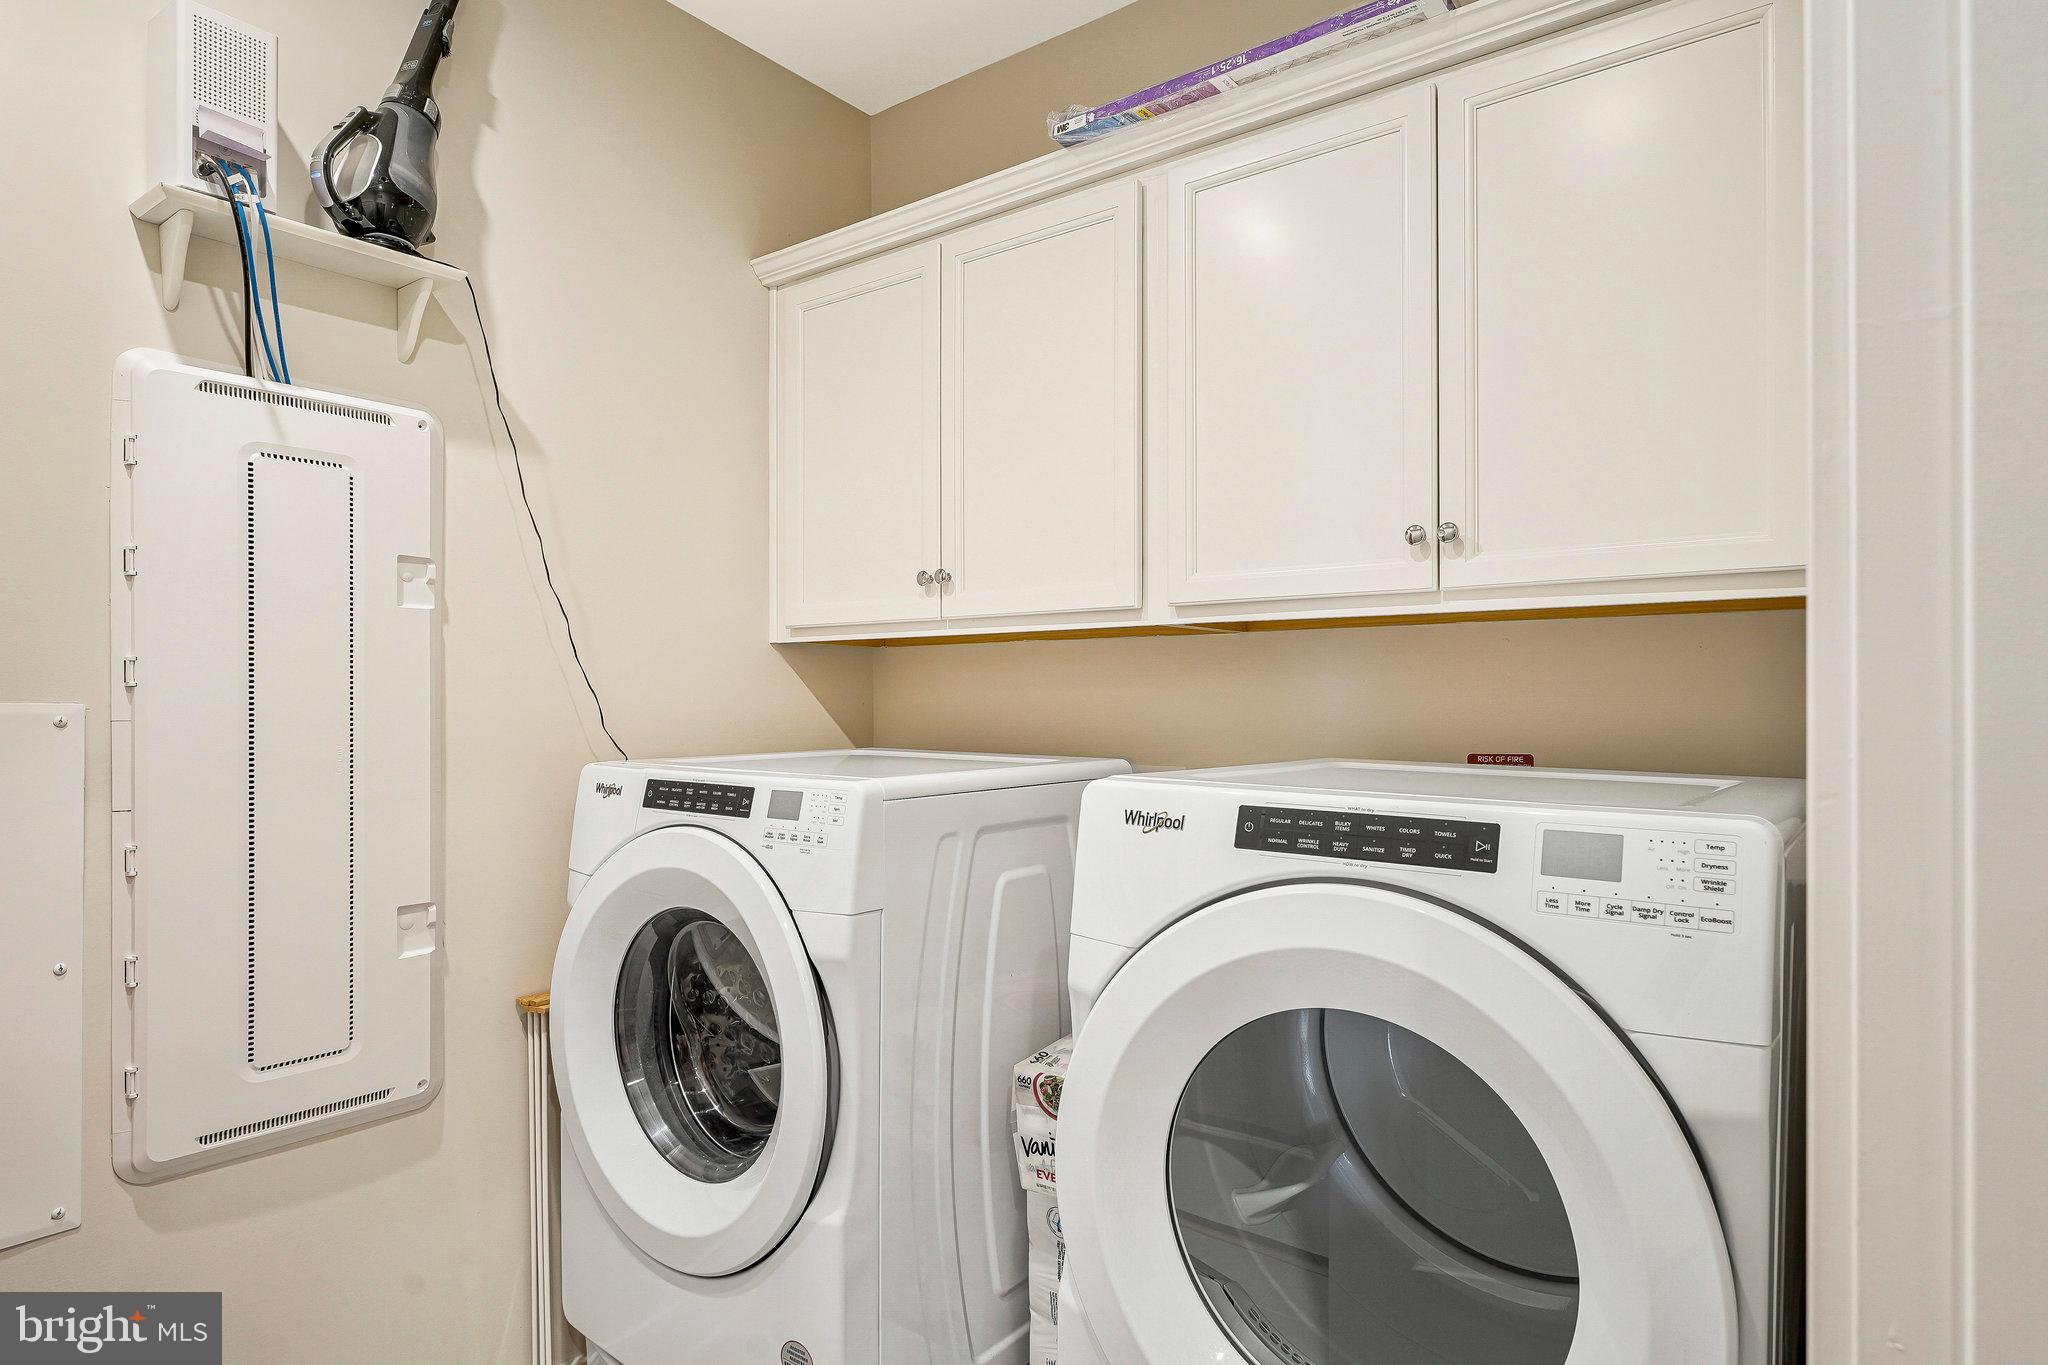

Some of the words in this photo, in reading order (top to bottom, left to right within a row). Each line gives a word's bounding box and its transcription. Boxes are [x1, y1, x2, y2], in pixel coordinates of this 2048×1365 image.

[1057, 122, 1070, 134] 3M
[596, 782, 623, 798] Whirlpool
[1125, 809, 1186, 833] Whirlpool
[1435, 830, 1457, 838] TOWELS
[1706, 843, 1726, 851] Temp
[1701, 862, 1729, 871] Dryness
[1701, 879, 1728, 887] Wrinkle
[1632, 906, 1651, 914] Damp
[1652, 908, 1665, 916] Dry
[1701, 916, 1733, 925] EcoBoost
[1017, 1075, 1032, 1085] 660
[1036, 1169, 1056, 1183] EVE
